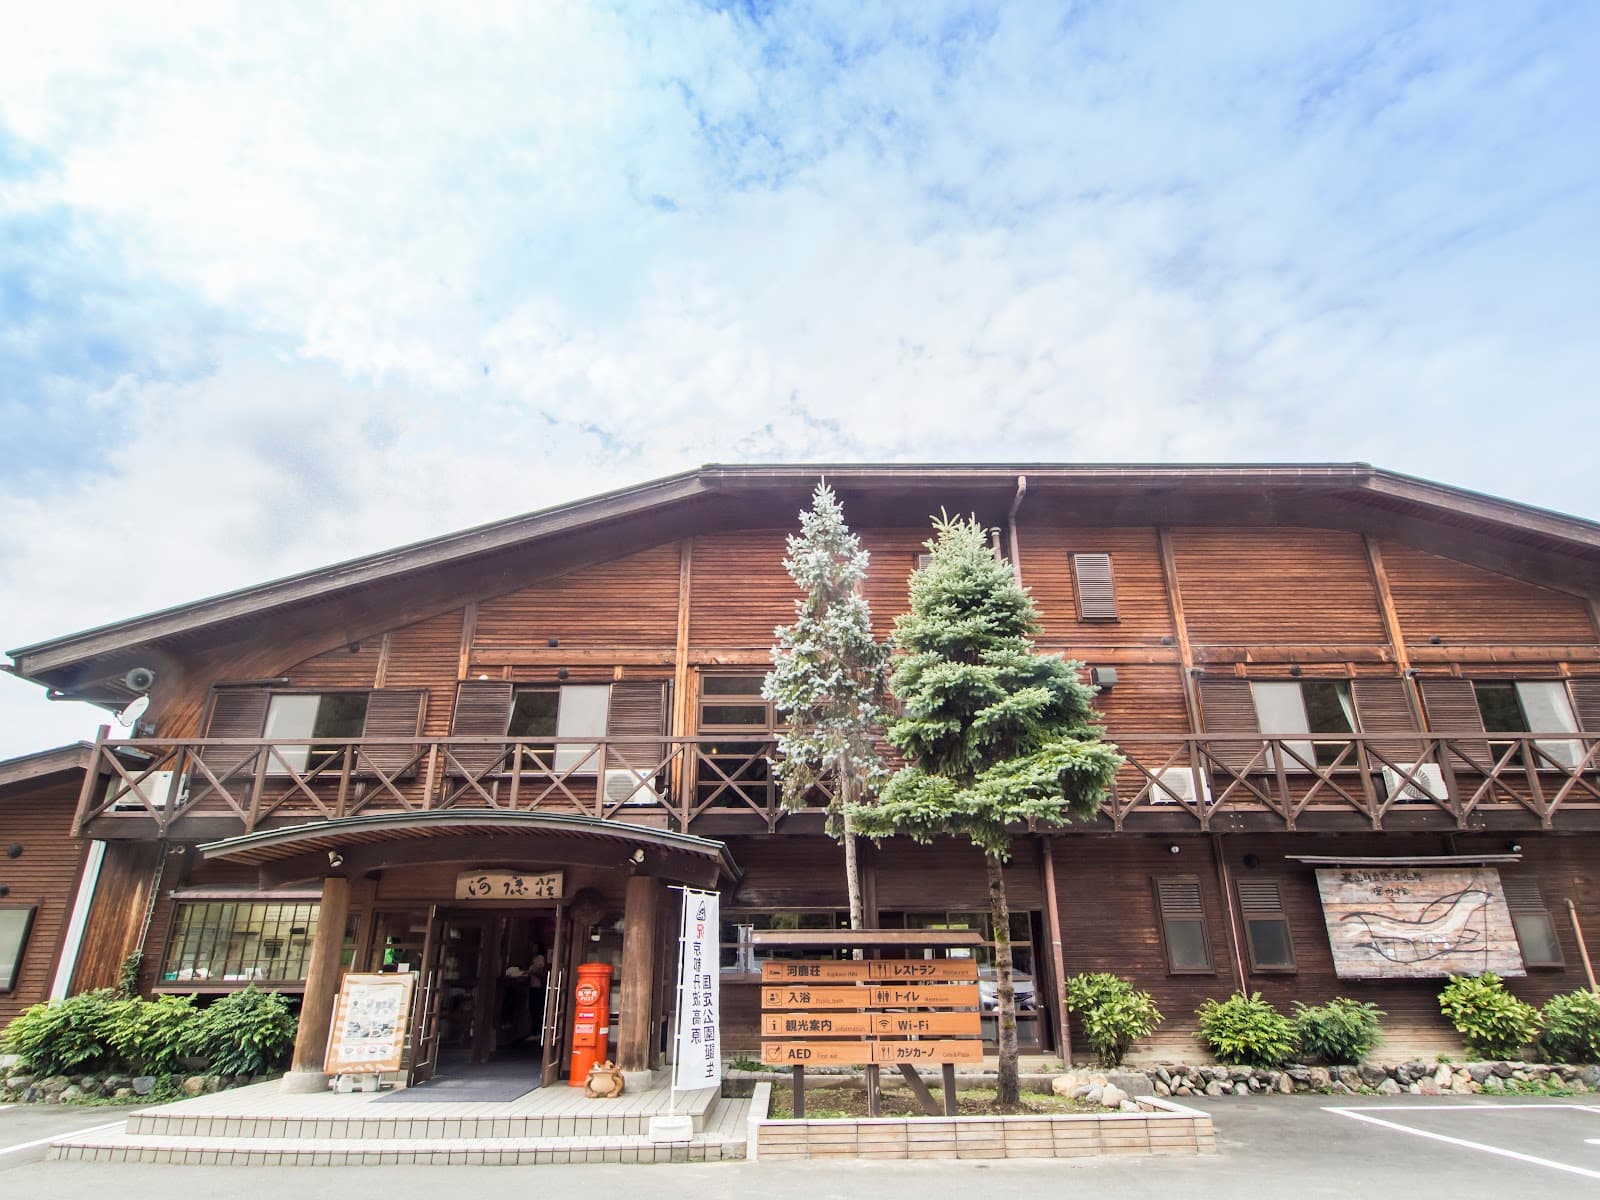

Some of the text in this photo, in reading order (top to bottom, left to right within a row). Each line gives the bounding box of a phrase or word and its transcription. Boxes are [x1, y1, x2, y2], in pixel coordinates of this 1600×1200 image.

[787, 965, 820, 976] 河鹿荘
[894, 965, 936, 976] レストラン
[788, 992, 810, 1003] 入浴
[895, 991, 920, 1002] トイレ
[786, 1020, 832, 1031] 観光案内
[898, 1020, 929, 1031] Wi-Fi
[788, 1048, 812, 1059] AED
